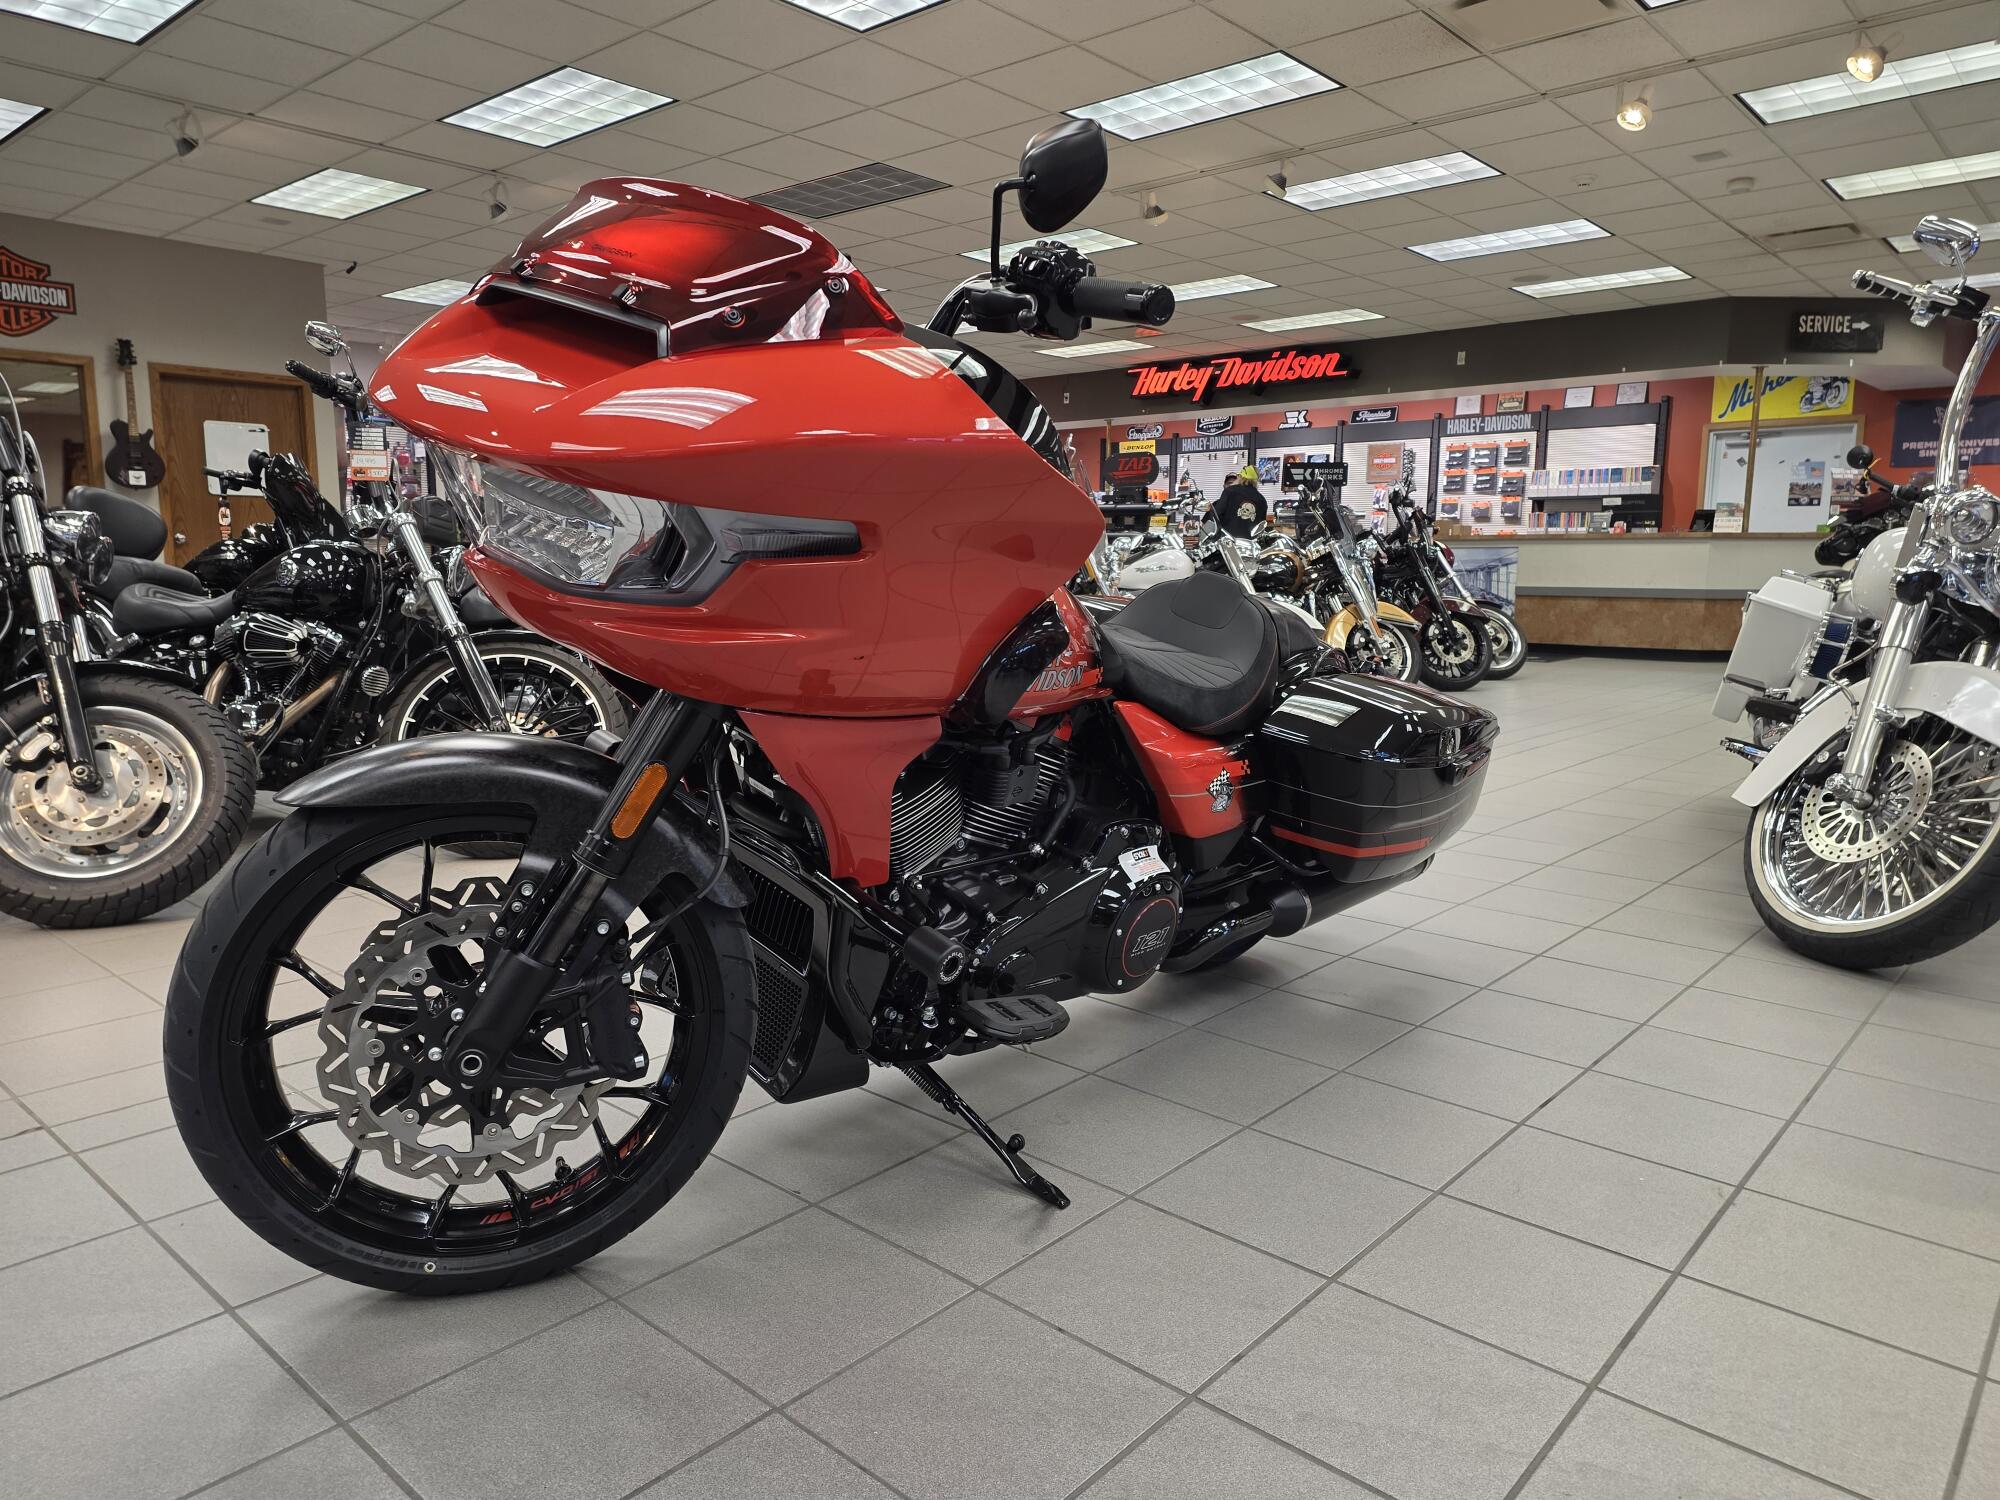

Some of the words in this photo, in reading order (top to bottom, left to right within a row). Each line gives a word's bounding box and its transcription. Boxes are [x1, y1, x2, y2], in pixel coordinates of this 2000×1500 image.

[0, 255, 38, 279] TOR
[0, 281, 67, 307] -DAVIDSON
[0, 304, 42, 330] CLES
[1798, 314, 1852, 334] SERVICE
[1127, 350, 1348, 402] Harley-Davidson
[1446, 413, 1532, 435] HARLEY-DAVIDSON
[1181, 434, 1244, 452] HARLEY-DAVIDSON
[1902, 441, 1938, 450] PREMI
[1118, 456, 1152, 474] TAB
[1132, 925, 1171, 953] 121
